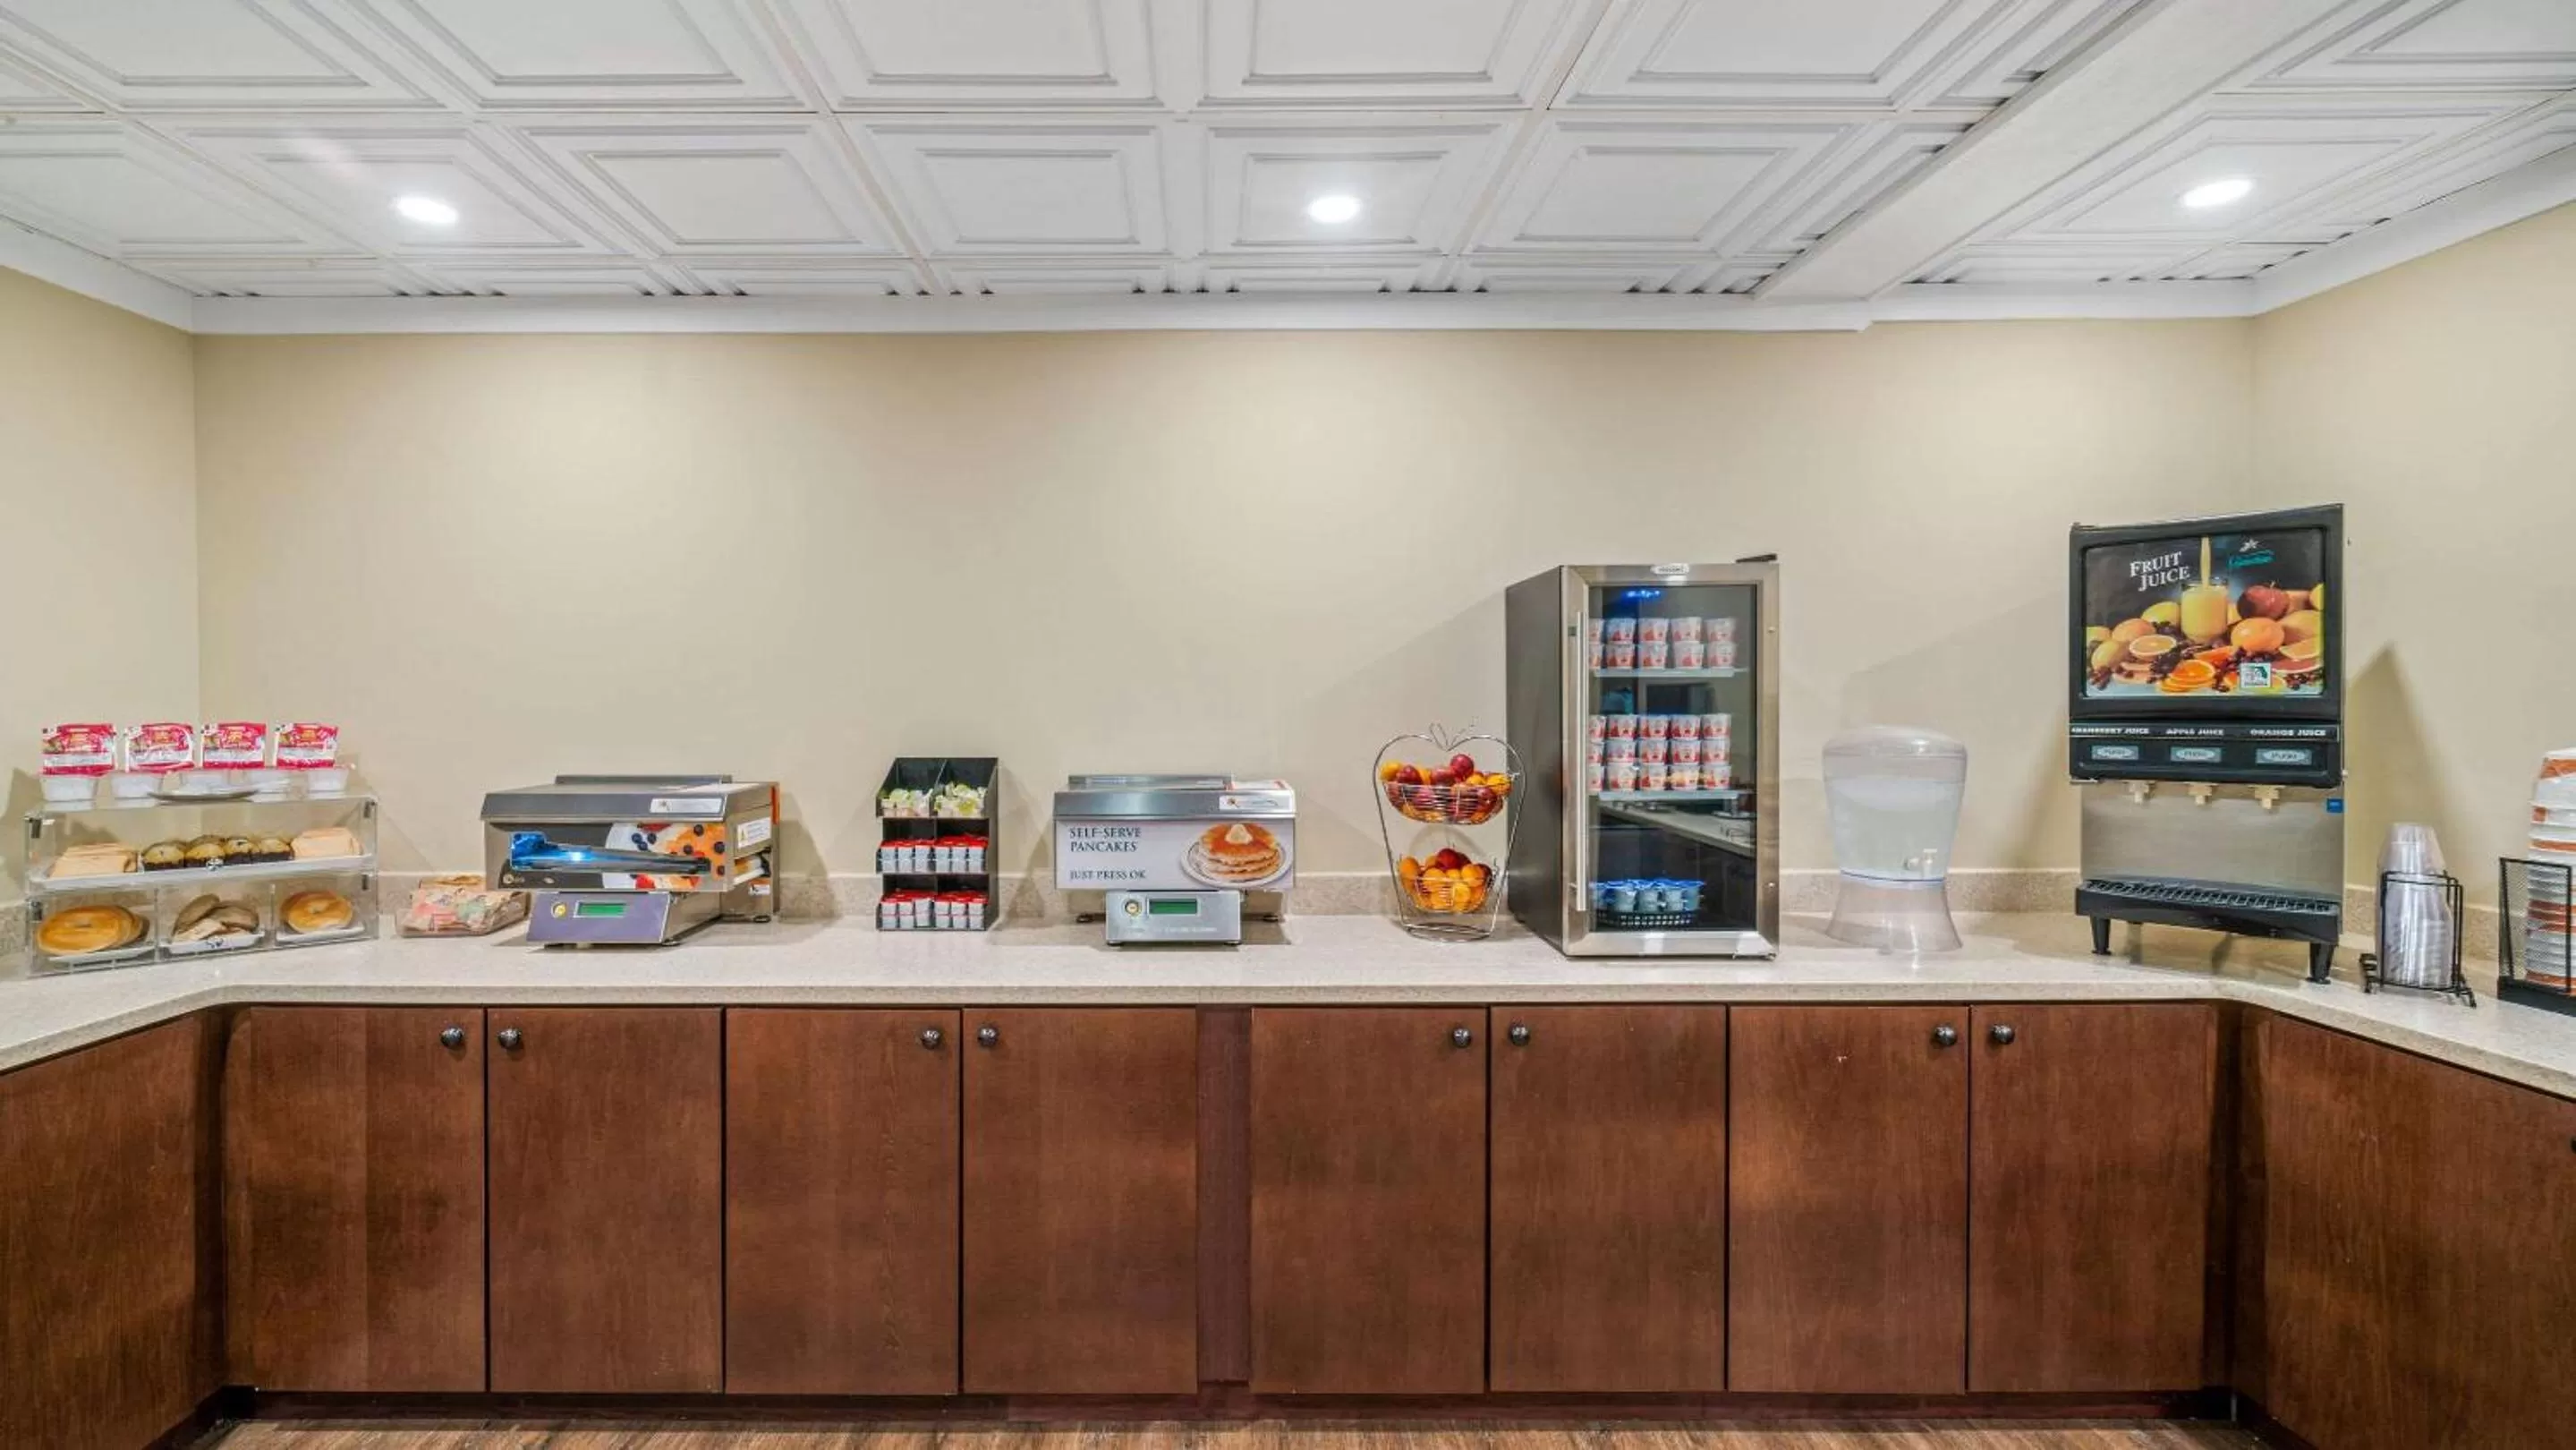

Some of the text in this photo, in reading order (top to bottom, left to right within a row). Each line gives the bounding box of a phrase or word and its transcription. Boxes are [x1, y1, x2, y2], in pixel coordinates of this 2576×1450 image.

[2130, 551, 2182, 577] FRUIT
[2138, 567, 2190, 592] JUICE
[2249, 728, 2294, 736] ORANGE
[1069, 827, 1142, 839] SELF-SERVE
[1070, 841, 1137, 852] PANCAKES
[1070, 870, 1146, 881] JUST PRESS OK
